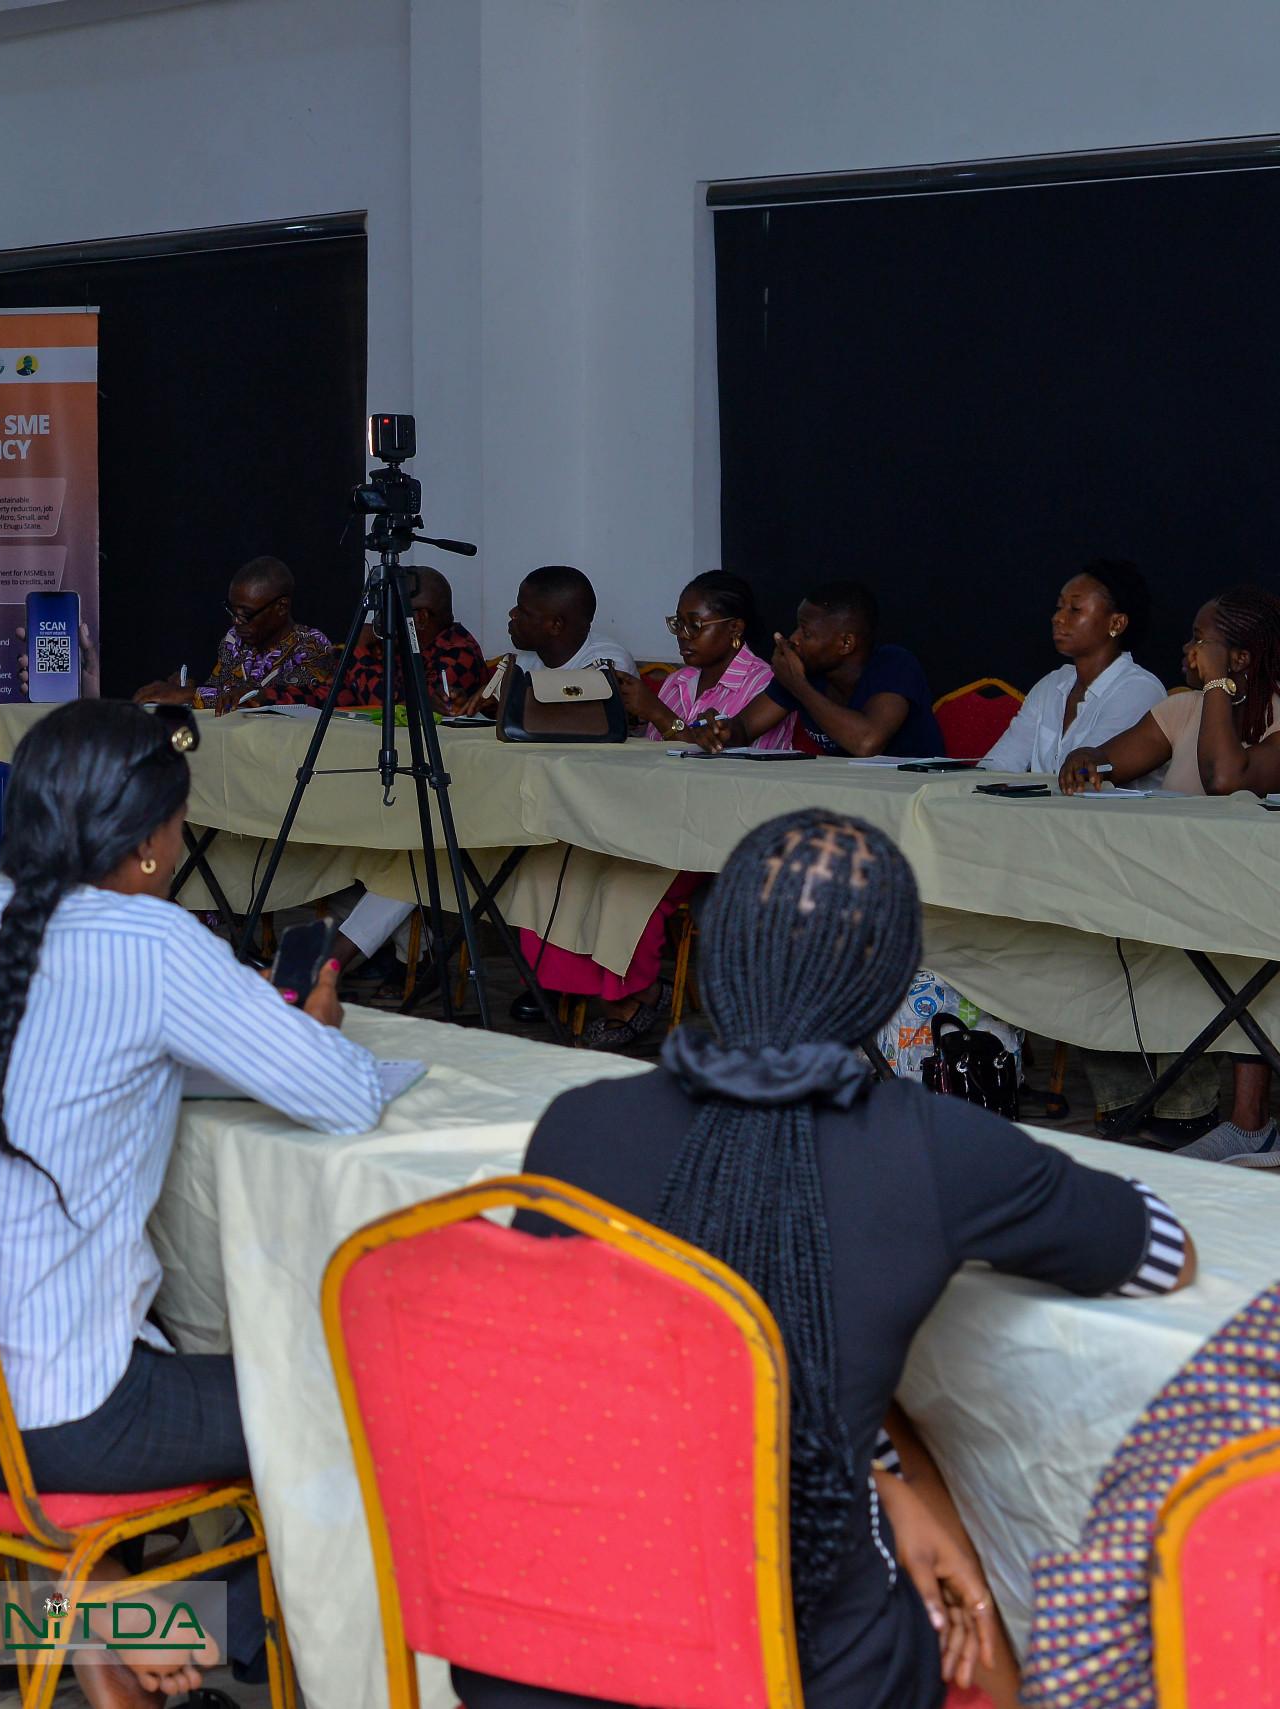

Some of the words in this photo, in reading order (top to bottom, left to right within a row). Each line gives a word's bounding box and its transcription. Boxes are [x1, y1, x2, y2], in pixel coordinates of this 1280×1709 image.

[4, 414, 50, 436] SME
[44, 504, 54, 513] job
[40, 622, 66, 630] SCAN
